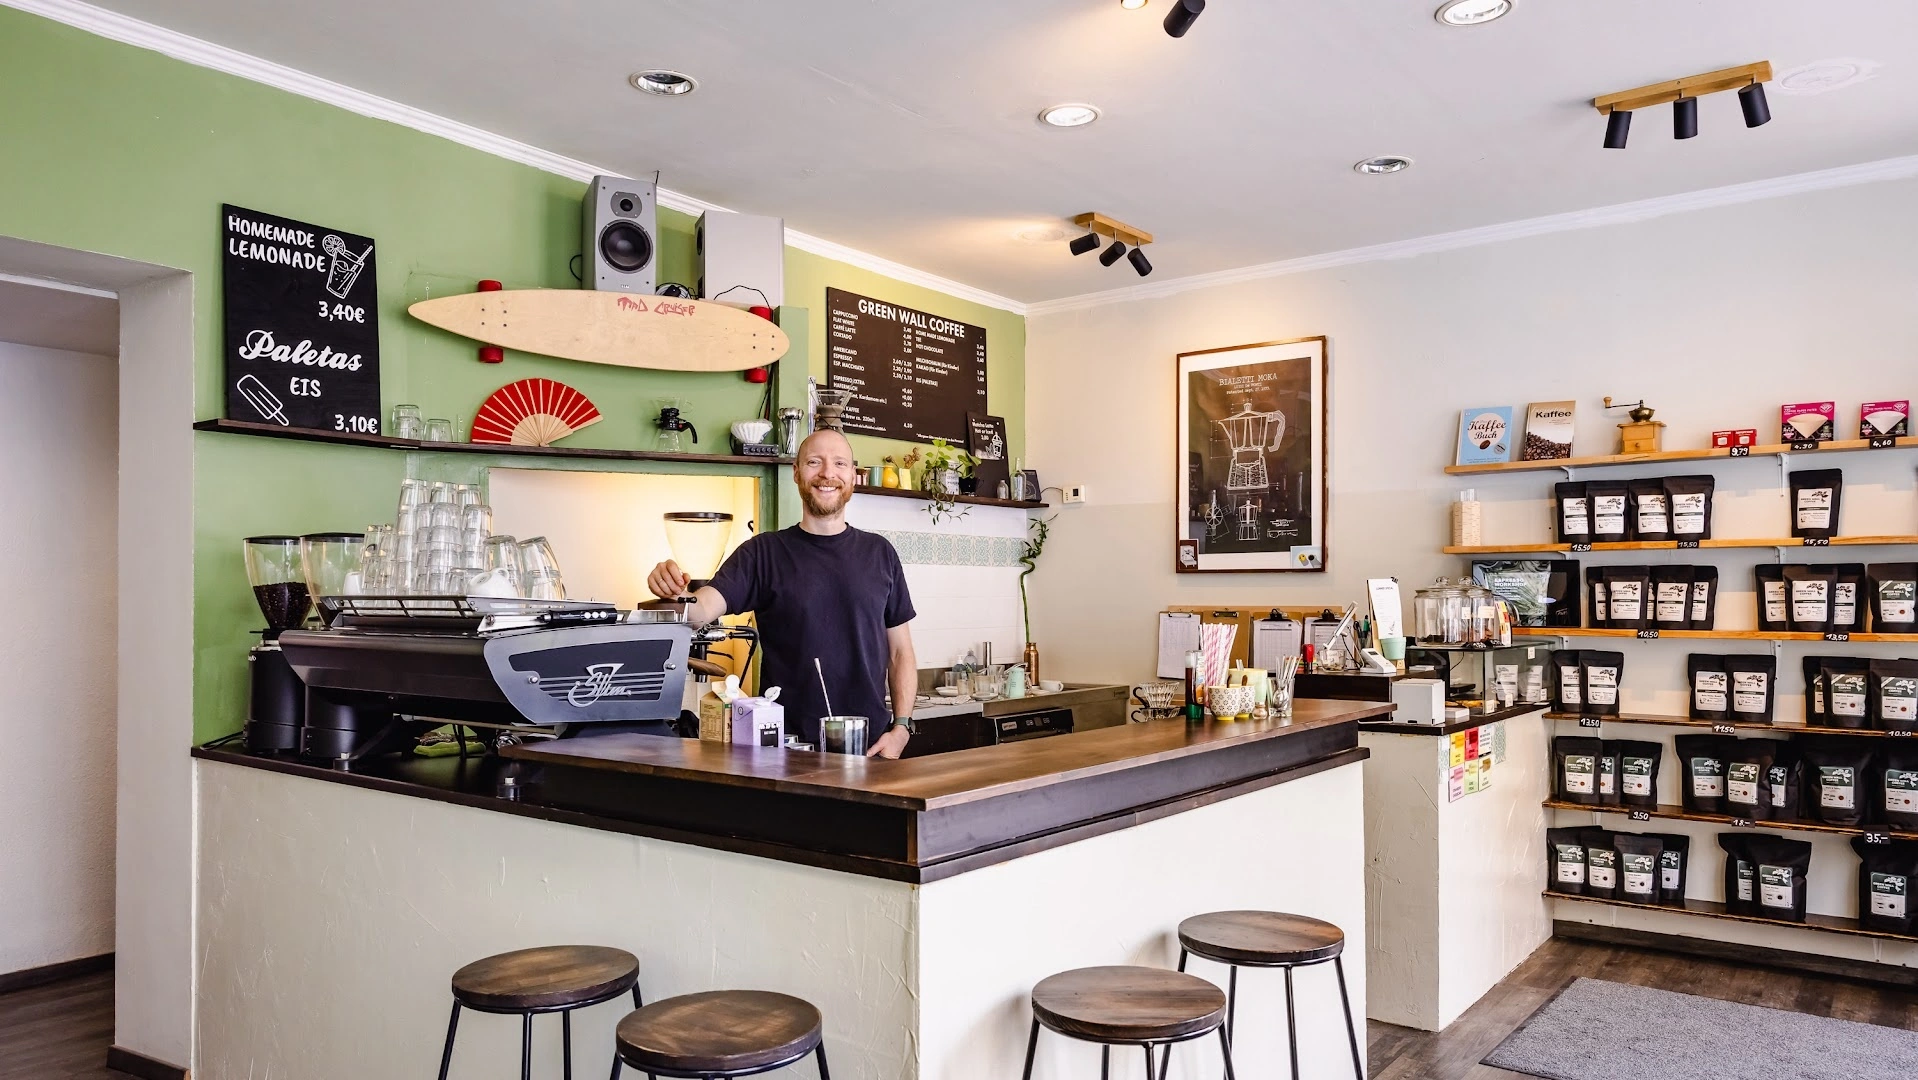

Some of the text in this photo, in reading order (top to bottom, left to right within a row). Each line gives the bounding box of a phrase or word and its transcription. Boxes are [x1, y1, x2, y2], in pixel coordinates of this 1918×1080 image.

[228, 215, 315, 249] HOMEMADE
[229, 238, 327, 273] LEMONADE
[318, 300, 365, 324] 3,40€
[833, 309, 858, 320] CAPPUCCINO
[858, 299, 965, 338] GREEN WALL COFFEE
[833, 331, 852, 340] CORTADO
[845, 326, 856, 334] LATTE
[937, 335, 955, 344] LEMONADE
[238, 329, 363, 372] Paletas
[833, 346, 858, 355] AMERICANO
[924, 345, 943, 354] CHOCOLATE
[833, 353, 852, 361] ESPRESSO
[842, 362, 864, 371] MACCHIATO
[833, 375, 852, 383] ESPRESSO
[1219, 373, 1277, 386] BIALETTI MOKA
[290, 376, 322, 398] EIS
[334, 414, 378, 434] 3,10€
[1467, 420, 1506, 432] Kaffee
[1474, 430, 1497, 439] Buch
